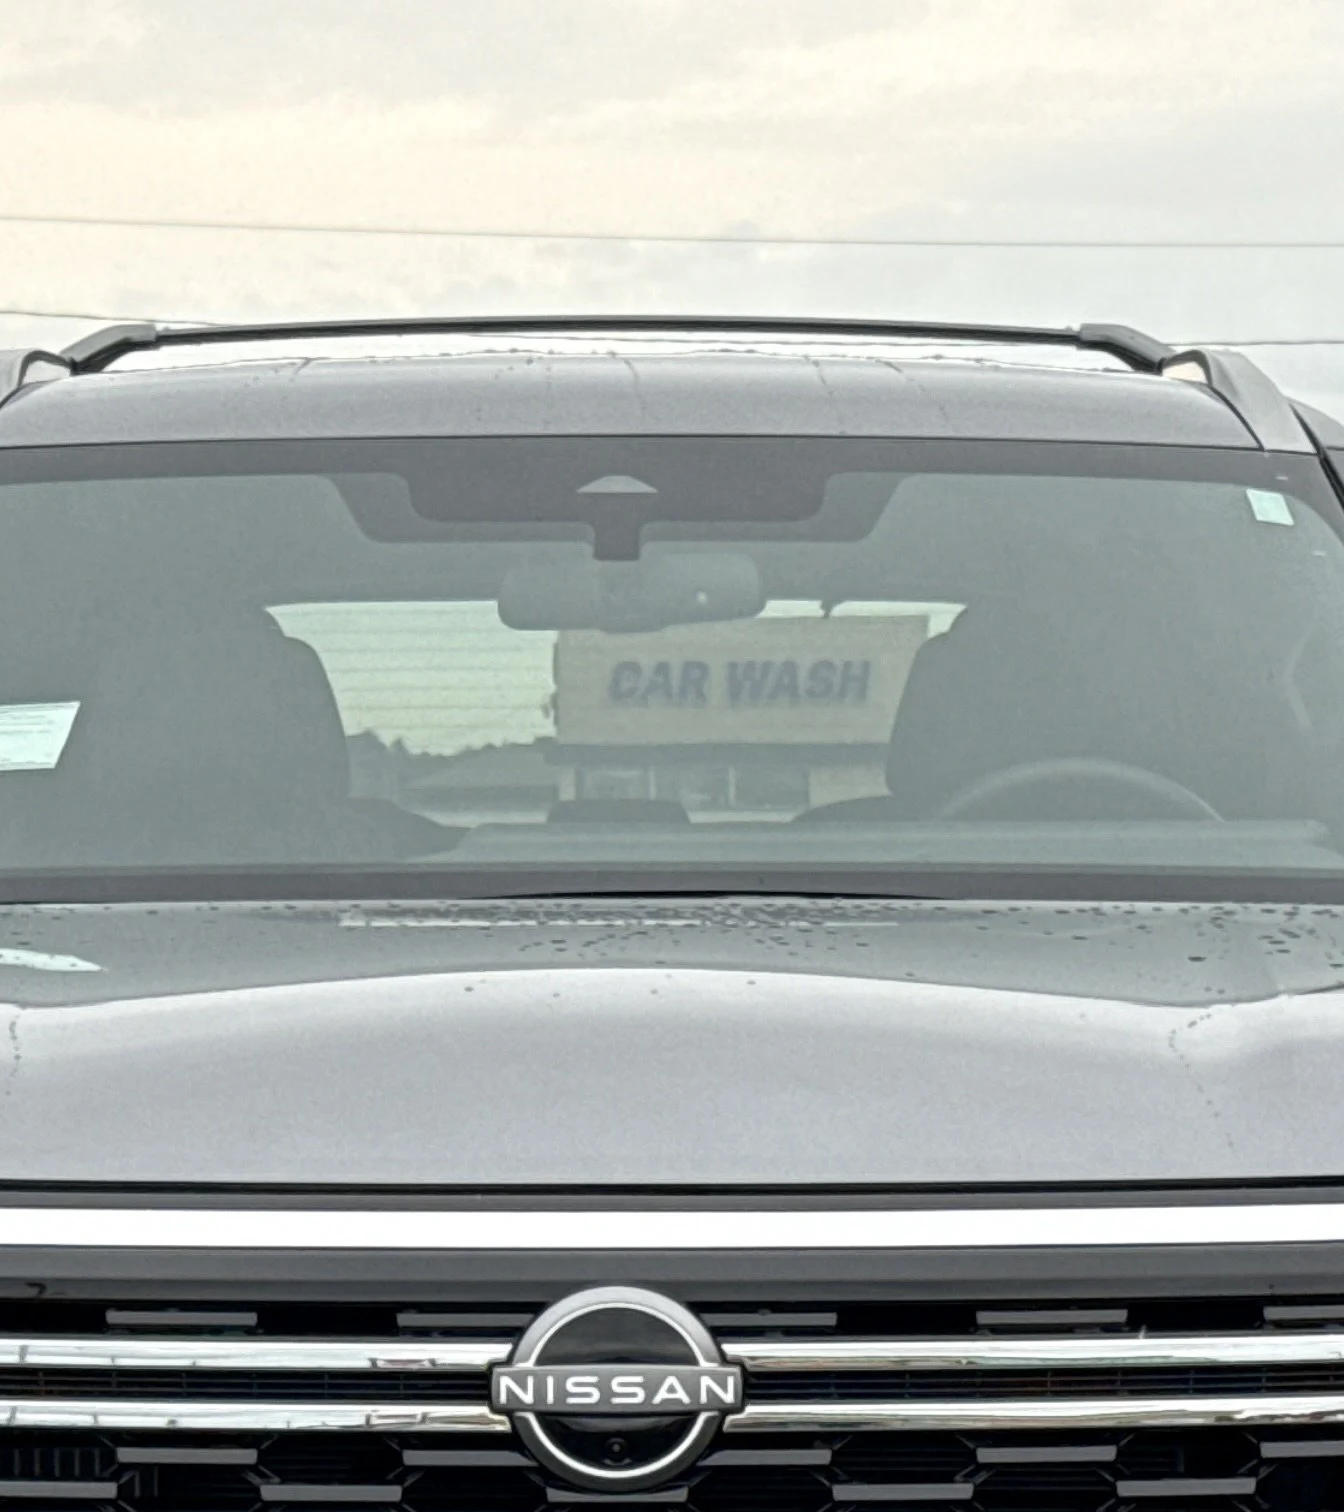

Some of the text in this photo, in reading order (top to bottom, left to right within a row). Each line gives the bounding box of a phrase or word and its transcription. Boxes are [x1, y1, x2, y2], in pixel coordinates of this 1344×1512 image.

[609, 658, 873, 704] CAR WASH
[499, 1375, 735, 1405] NISSAN
